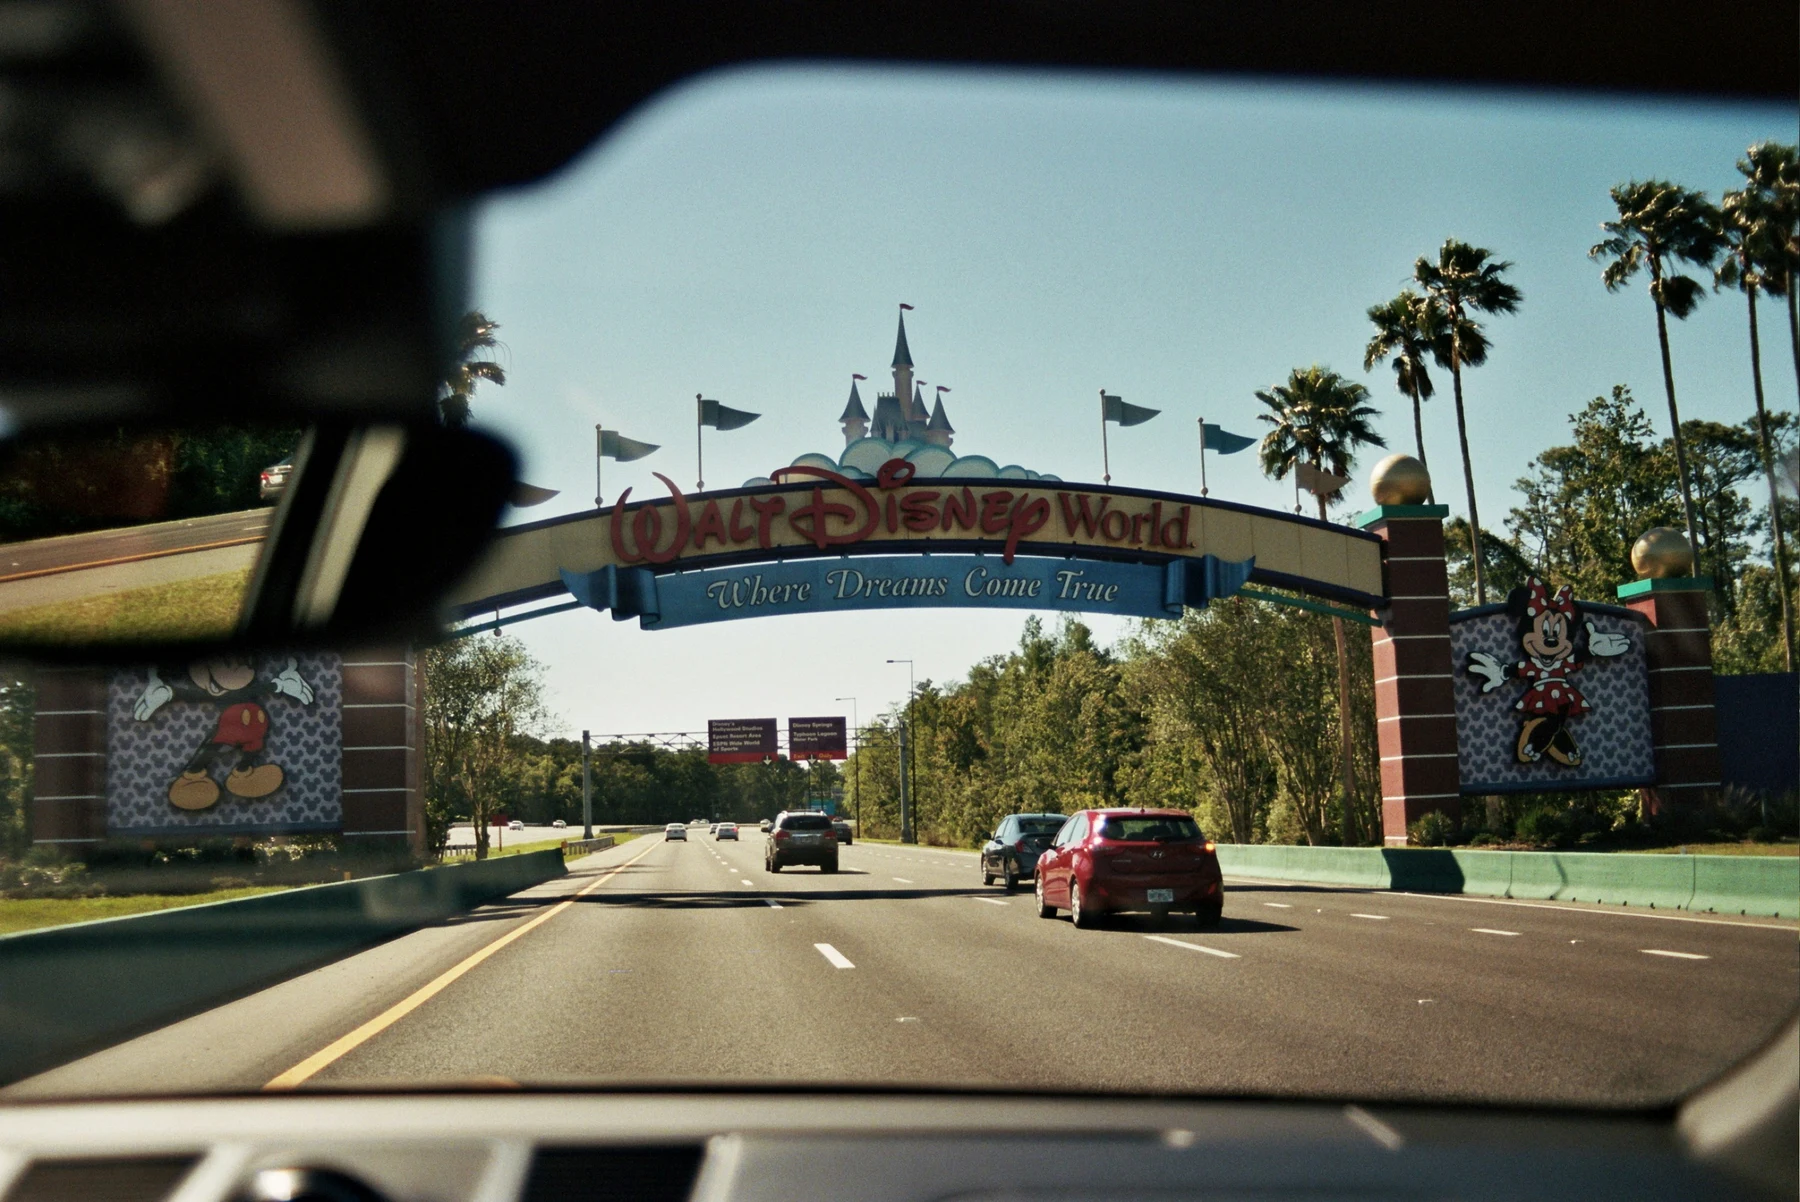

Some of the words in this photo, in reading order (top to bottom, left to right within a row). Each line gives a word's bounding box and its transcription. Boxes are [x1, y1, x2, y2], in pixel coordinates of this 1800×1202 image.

[707, 575, 811, 609] Where
[826, 568, 949, 599] Dreams
[964, 566, 1042, 598] Come
[1056, 570, 1120, 602] True
